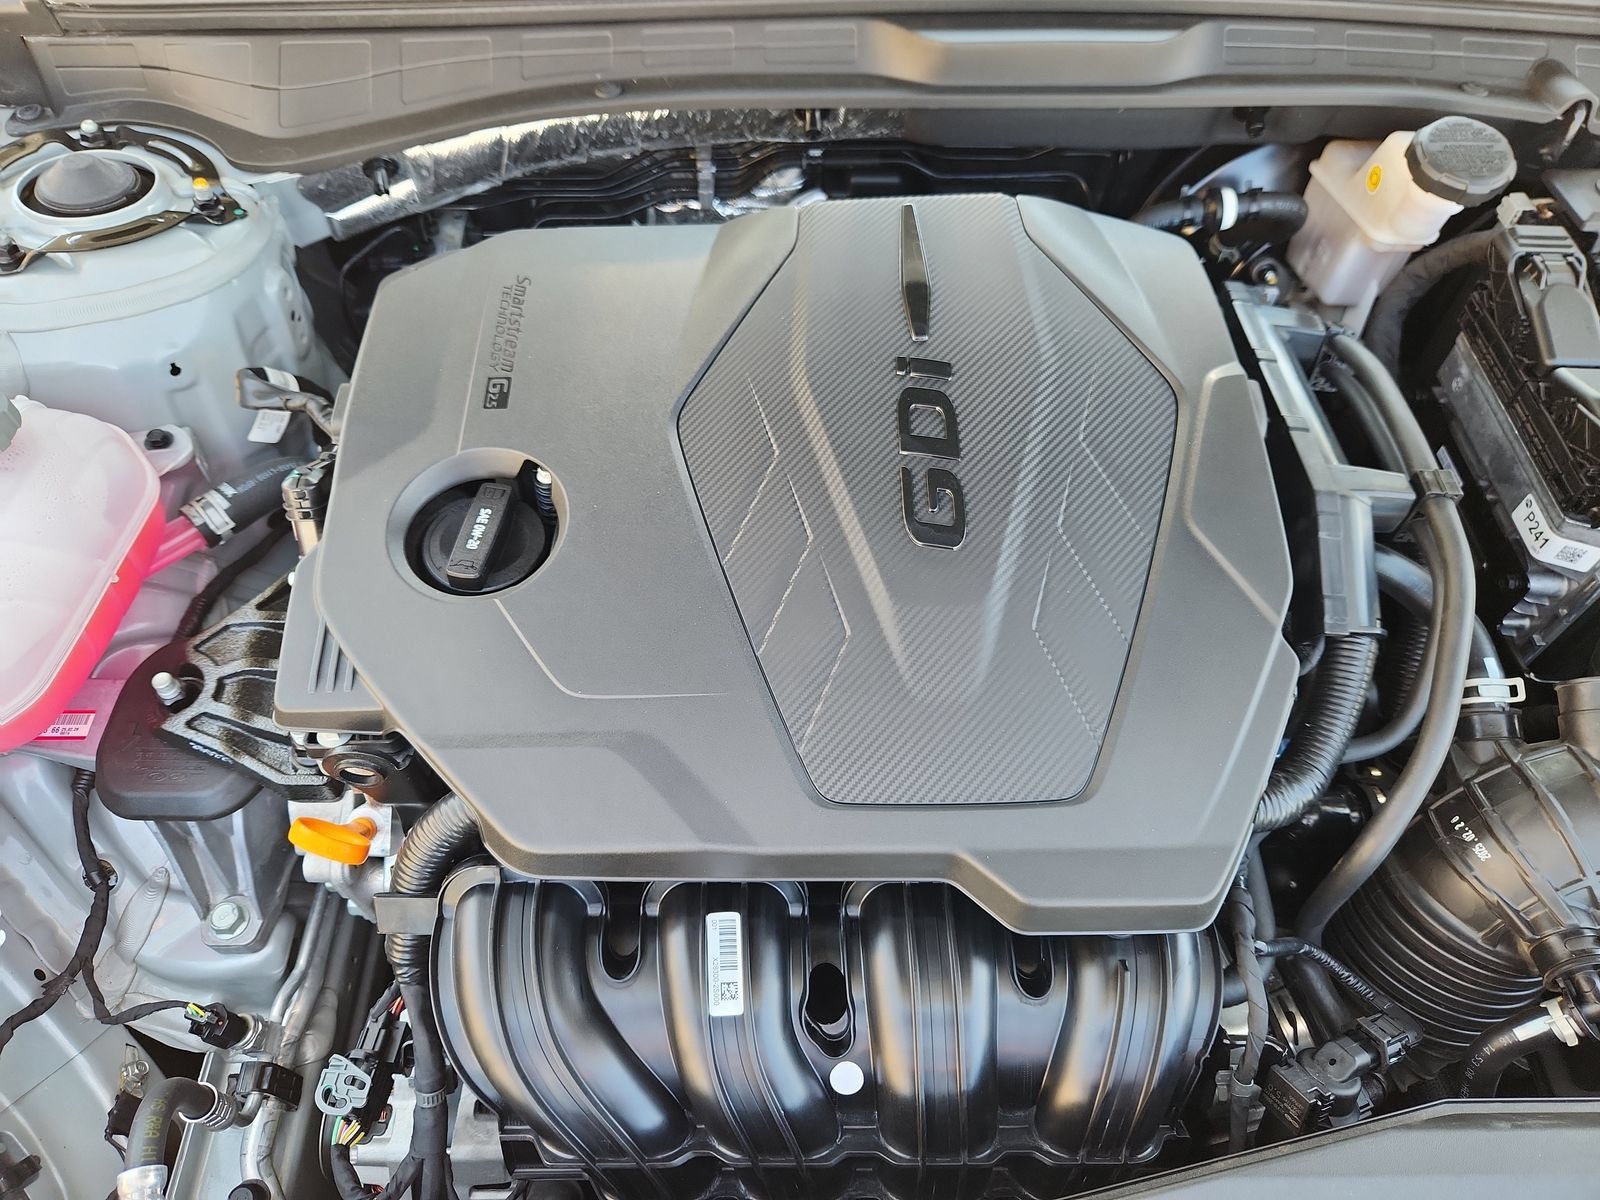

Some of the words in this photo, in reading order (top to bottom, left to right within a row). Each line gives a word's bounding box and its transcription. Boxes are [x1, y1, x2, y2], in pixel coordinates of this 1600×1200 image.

[489, 285, 513, 373] TECHNOLOGY
[500, 274, 532, 373] Smartstream
[896, 356, 967, 551] GDi
[476, 508, 492, 525] SAE
[1523, 511, 1550, 549] P241
